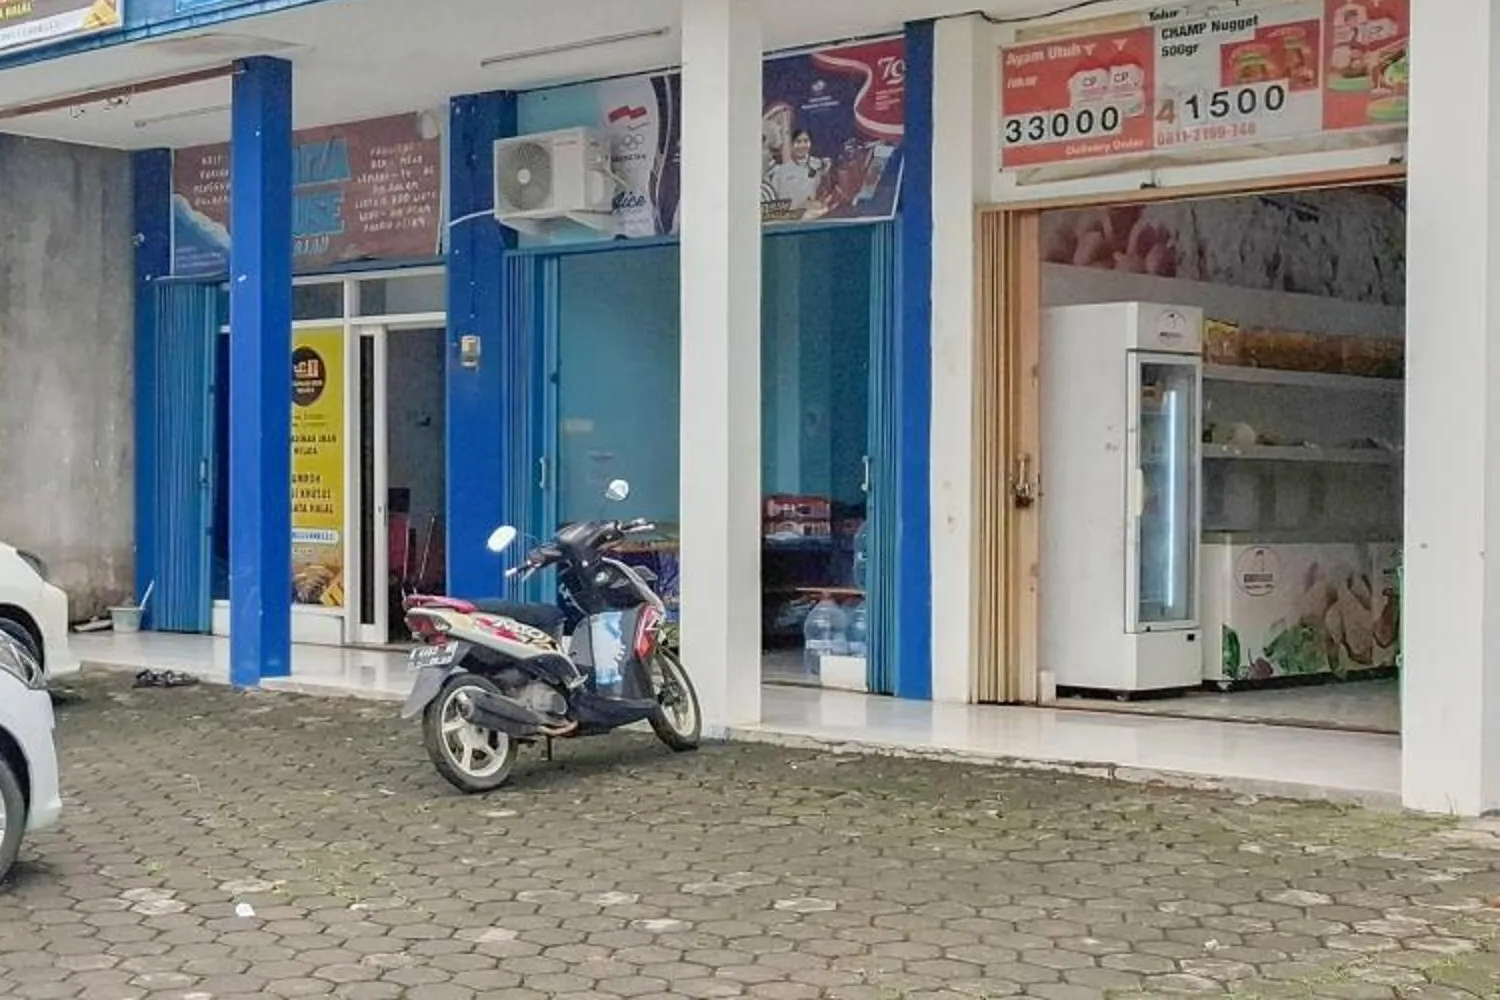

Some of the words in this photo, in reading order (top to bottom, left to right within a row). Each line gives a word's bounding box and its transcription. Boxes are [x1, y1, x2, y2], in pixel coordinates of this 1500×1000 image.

[1161, 22, 1208, 41] CHAMP
[1211, 14, 1260, 34] Nugget
[1161, 43, 1200, 59] 500gr
[1004, 105, 1119, 143] 33000
